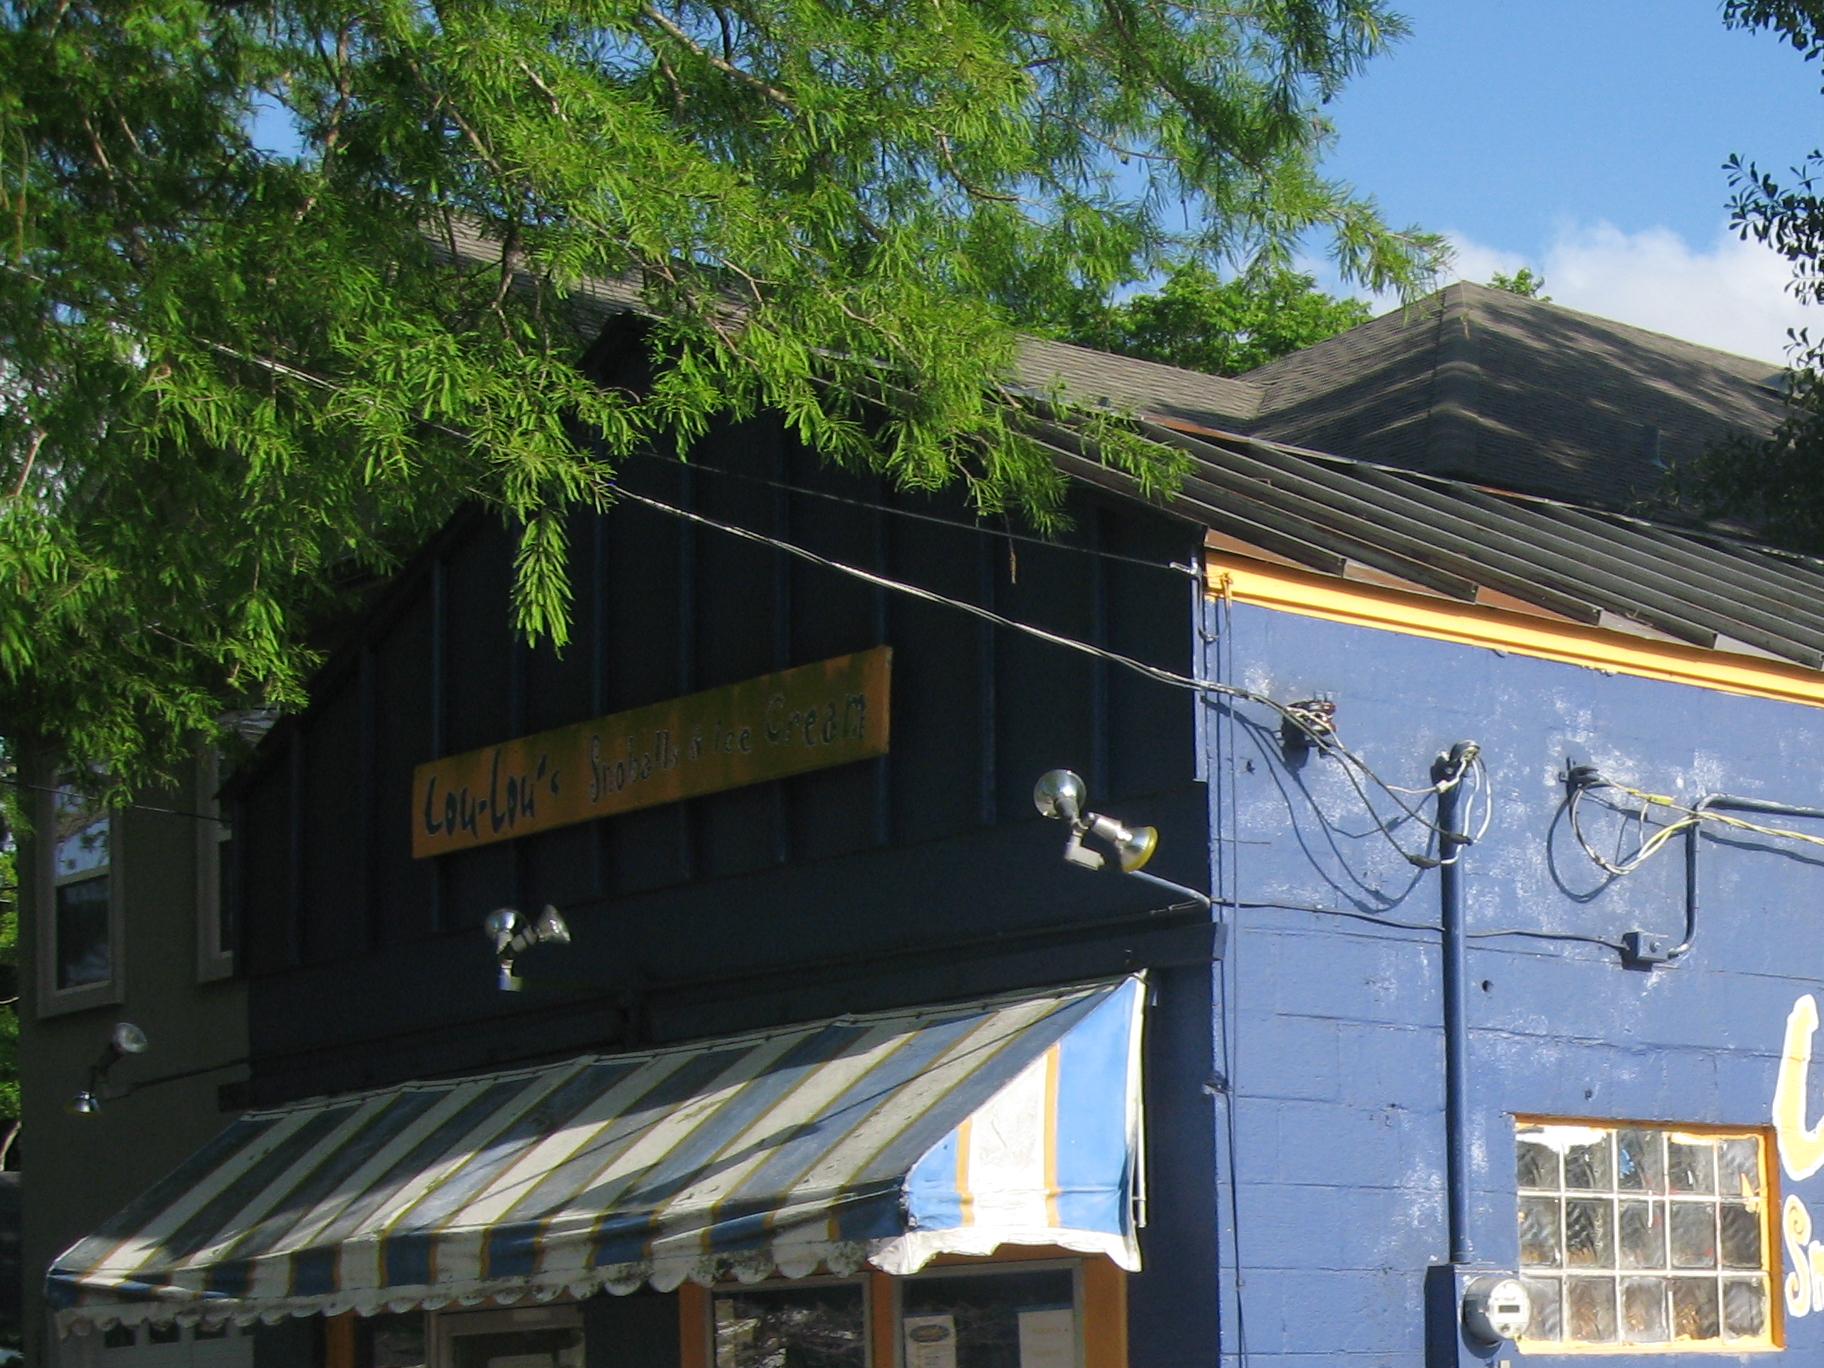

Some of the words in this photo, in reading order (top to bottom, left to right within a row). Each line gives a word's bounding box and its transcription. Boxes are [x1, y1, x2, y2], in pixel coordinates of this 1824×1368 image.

[424, 749, 561, 838] Lou-Lou's
[588, 734, 679, 803] Snoballs
[714, 720, 753, 754] Ice
[763, 692, 867, 747] Cream
